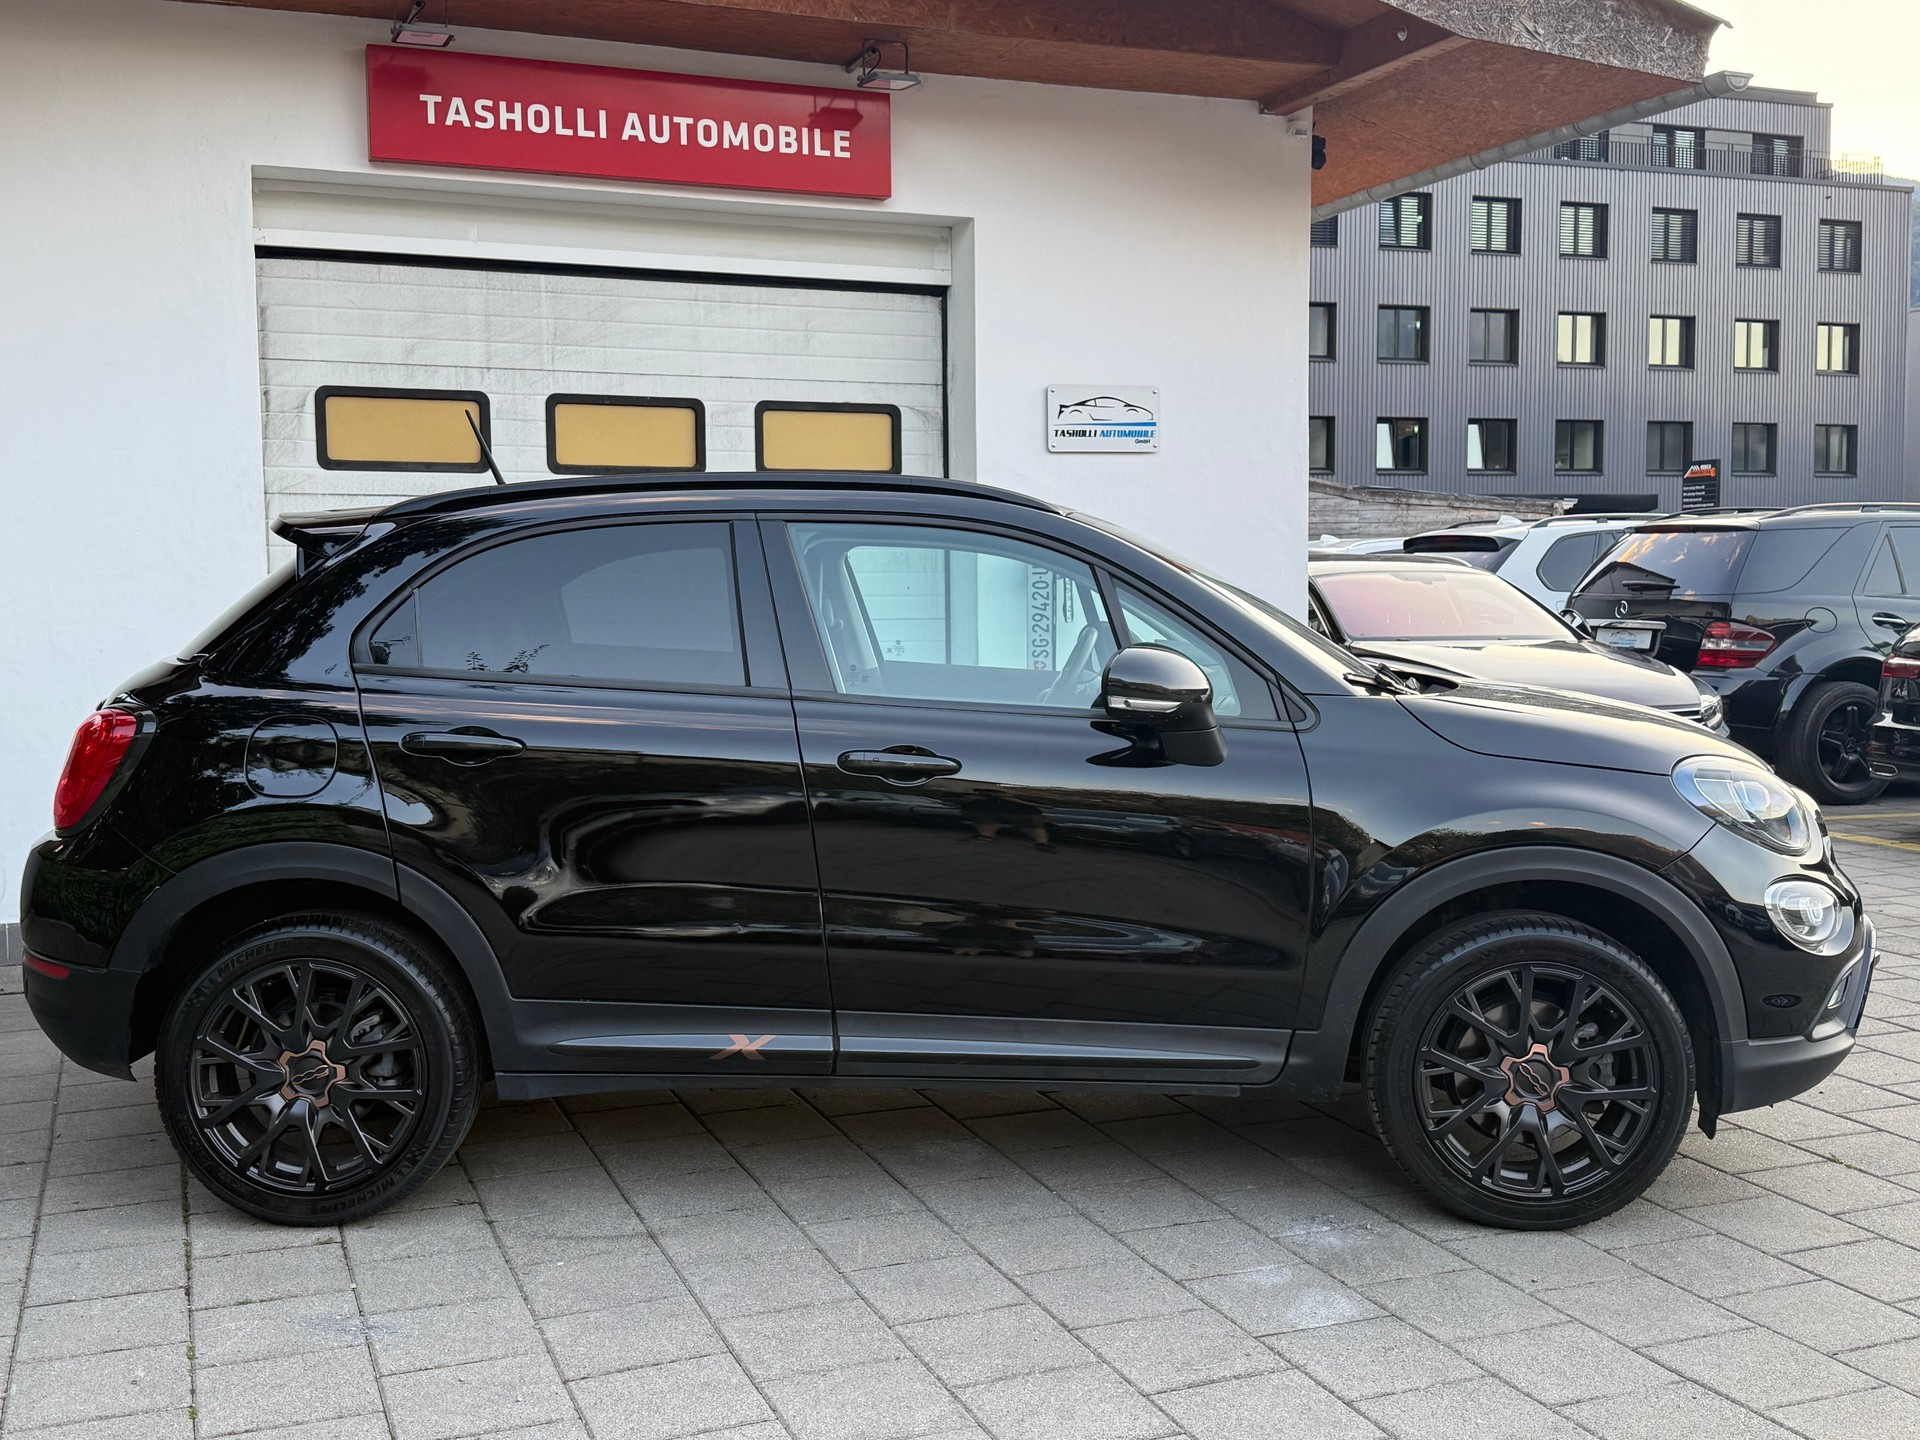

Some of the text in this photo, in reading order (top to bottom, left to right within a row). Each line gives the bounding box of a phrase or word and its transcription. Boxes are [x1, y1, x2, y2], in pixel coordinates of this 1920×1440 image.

[418, 93, 852, 159] TASHOLLI AUTOMOBILE
[1054, 429, 1156, 438] TASHOLLI AUTOMOBILE
